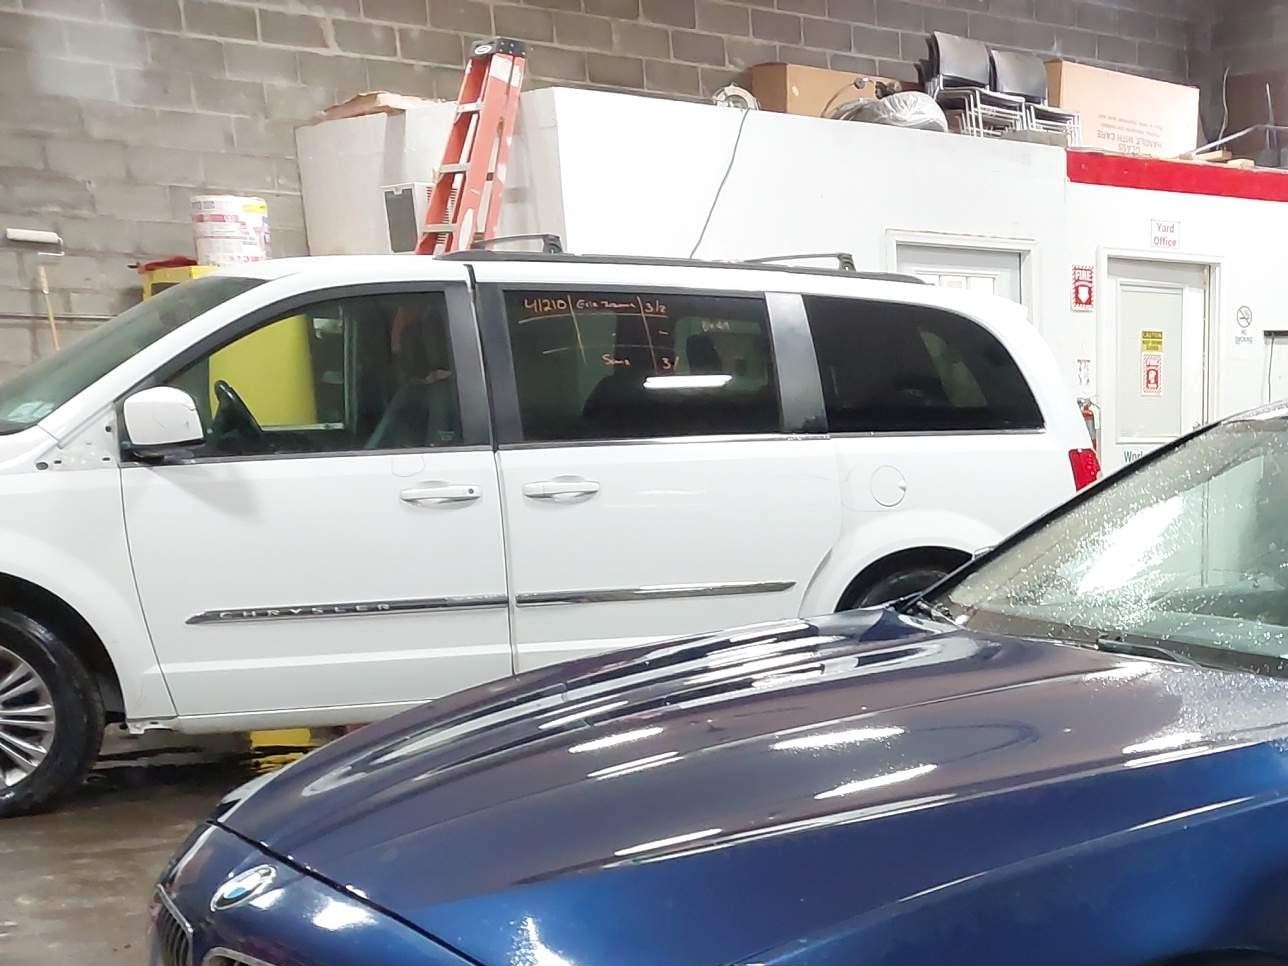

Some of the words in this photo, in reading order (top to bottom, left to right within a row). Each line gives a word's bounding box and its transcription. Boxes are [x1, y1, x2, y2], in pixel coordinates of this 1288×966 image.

[1156, 222, 1175, 233] Yard
[1153, 235, 1177, 247] Office
[218, 602, 392, 619] CHRYSLER
